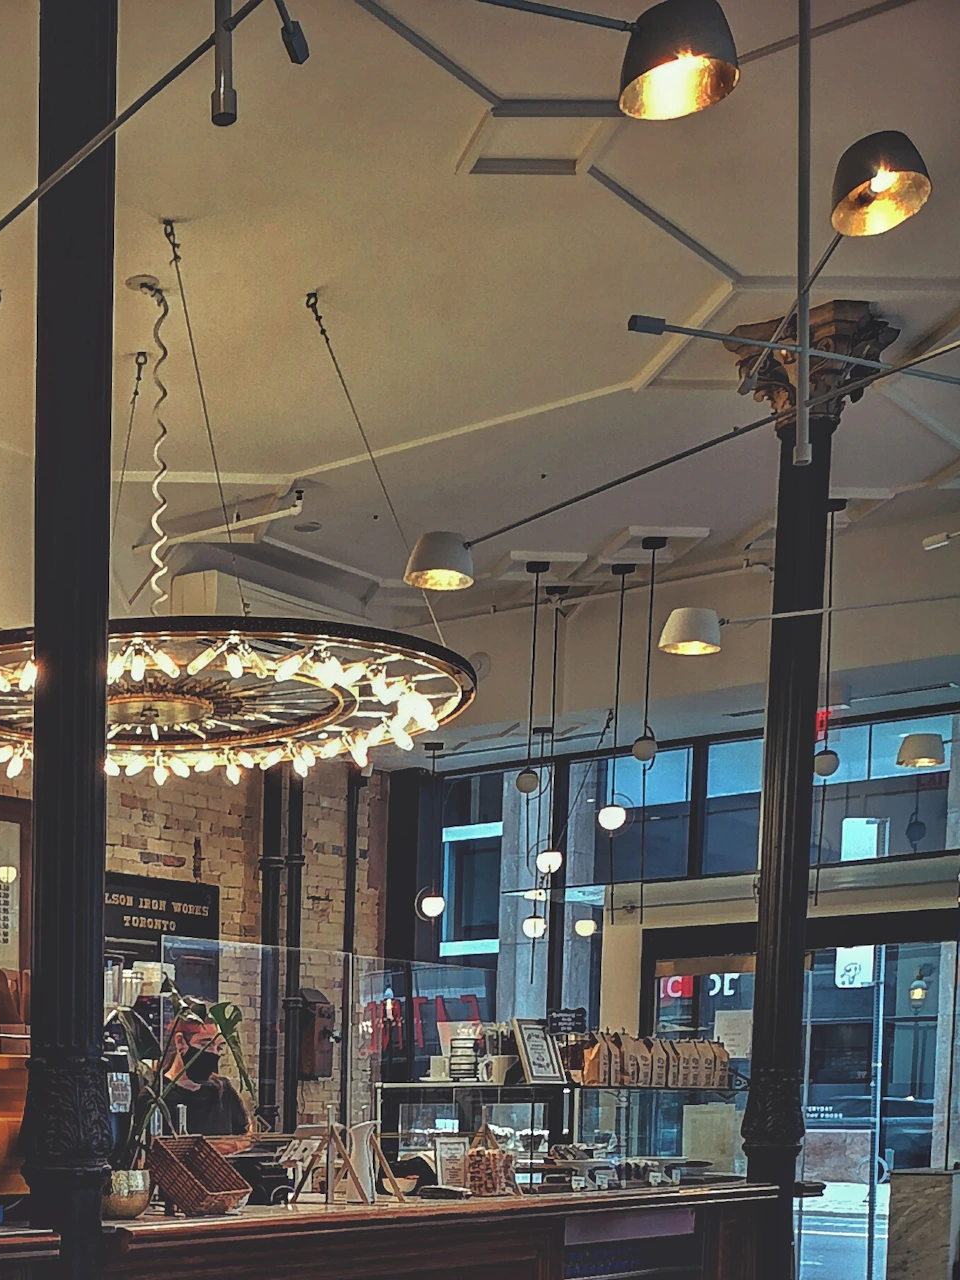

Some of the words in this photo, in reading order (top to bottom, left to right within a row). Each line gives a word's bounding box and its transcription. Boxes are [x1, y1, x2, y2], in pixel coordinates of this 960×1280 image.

[138, 897, 167, 912] IRON
[172, 901, 210, 917] WORKS
[123, 915, 177, 932] TORONTO
